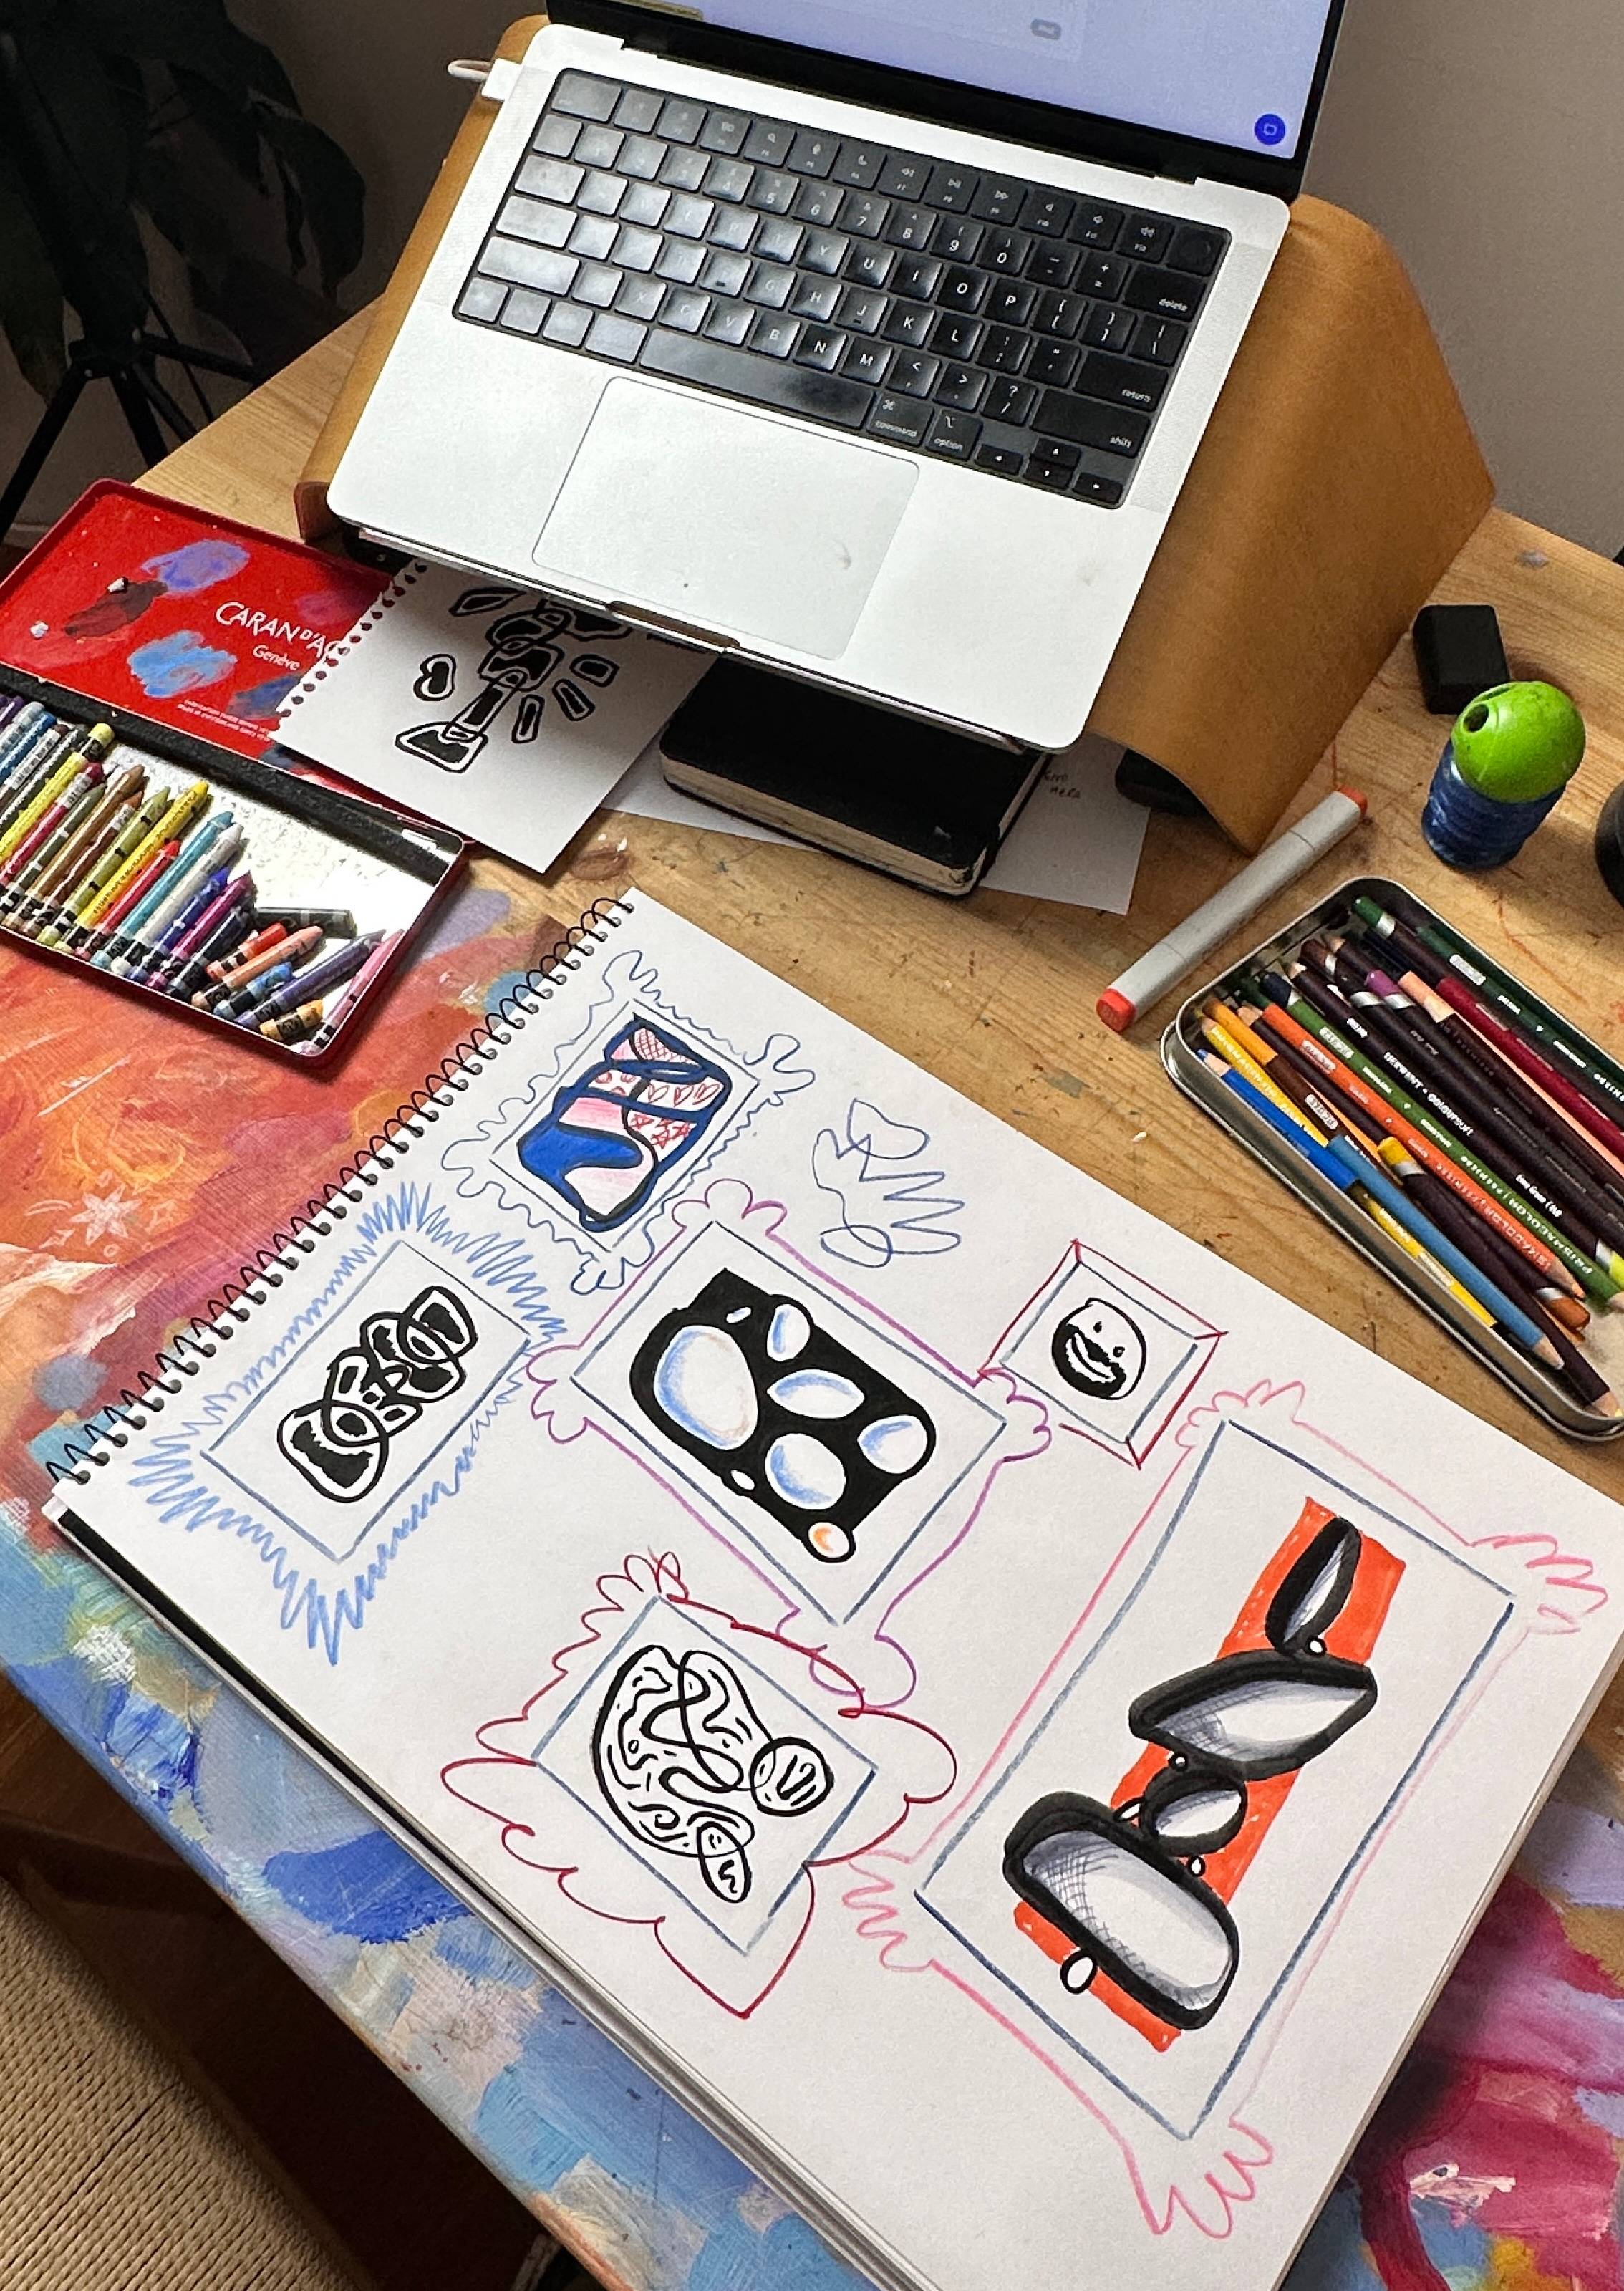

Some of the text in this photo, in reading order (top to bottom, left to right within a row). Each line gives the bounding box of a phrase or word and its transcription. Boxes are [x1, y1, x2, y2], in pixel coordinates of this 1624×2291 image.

[766, 192, 775, 203] 5
[811, 204, 821, 216] 6
[857, 216, 866, 226] 7
[902, 228, 913, 239] 8
[949, 239, 960, 251] 9
[864, 257, 875, 269] U
[997, 252, 1007, 264] 0
[913, 270, 919, 281] I
[957, 283, 968, 294] O
[809, 291, 821, 303] H
[1005, 295, 1016, 307] P
[856, 305, 866, 317] J
[725, 316, 737, 328] V
[903, 317, 914, 329] K
[769, 329, 780, 340] B
[951, 329, 959, 342] L
[813, 340, 826, 354] N
[859, 354, 874, 367] M
[1010, 385, 1018, 397] ?
[875, 420, 918, 438] command
[934, 438, 963, 450] option
[1111, 437, 1132, 448] shift
[216, 602, 301, 644] CARAN
[1384, 1051, 1424, 1089] DERWENT
[1508, 1198, 1593, 1274] PRISMACOLOR
